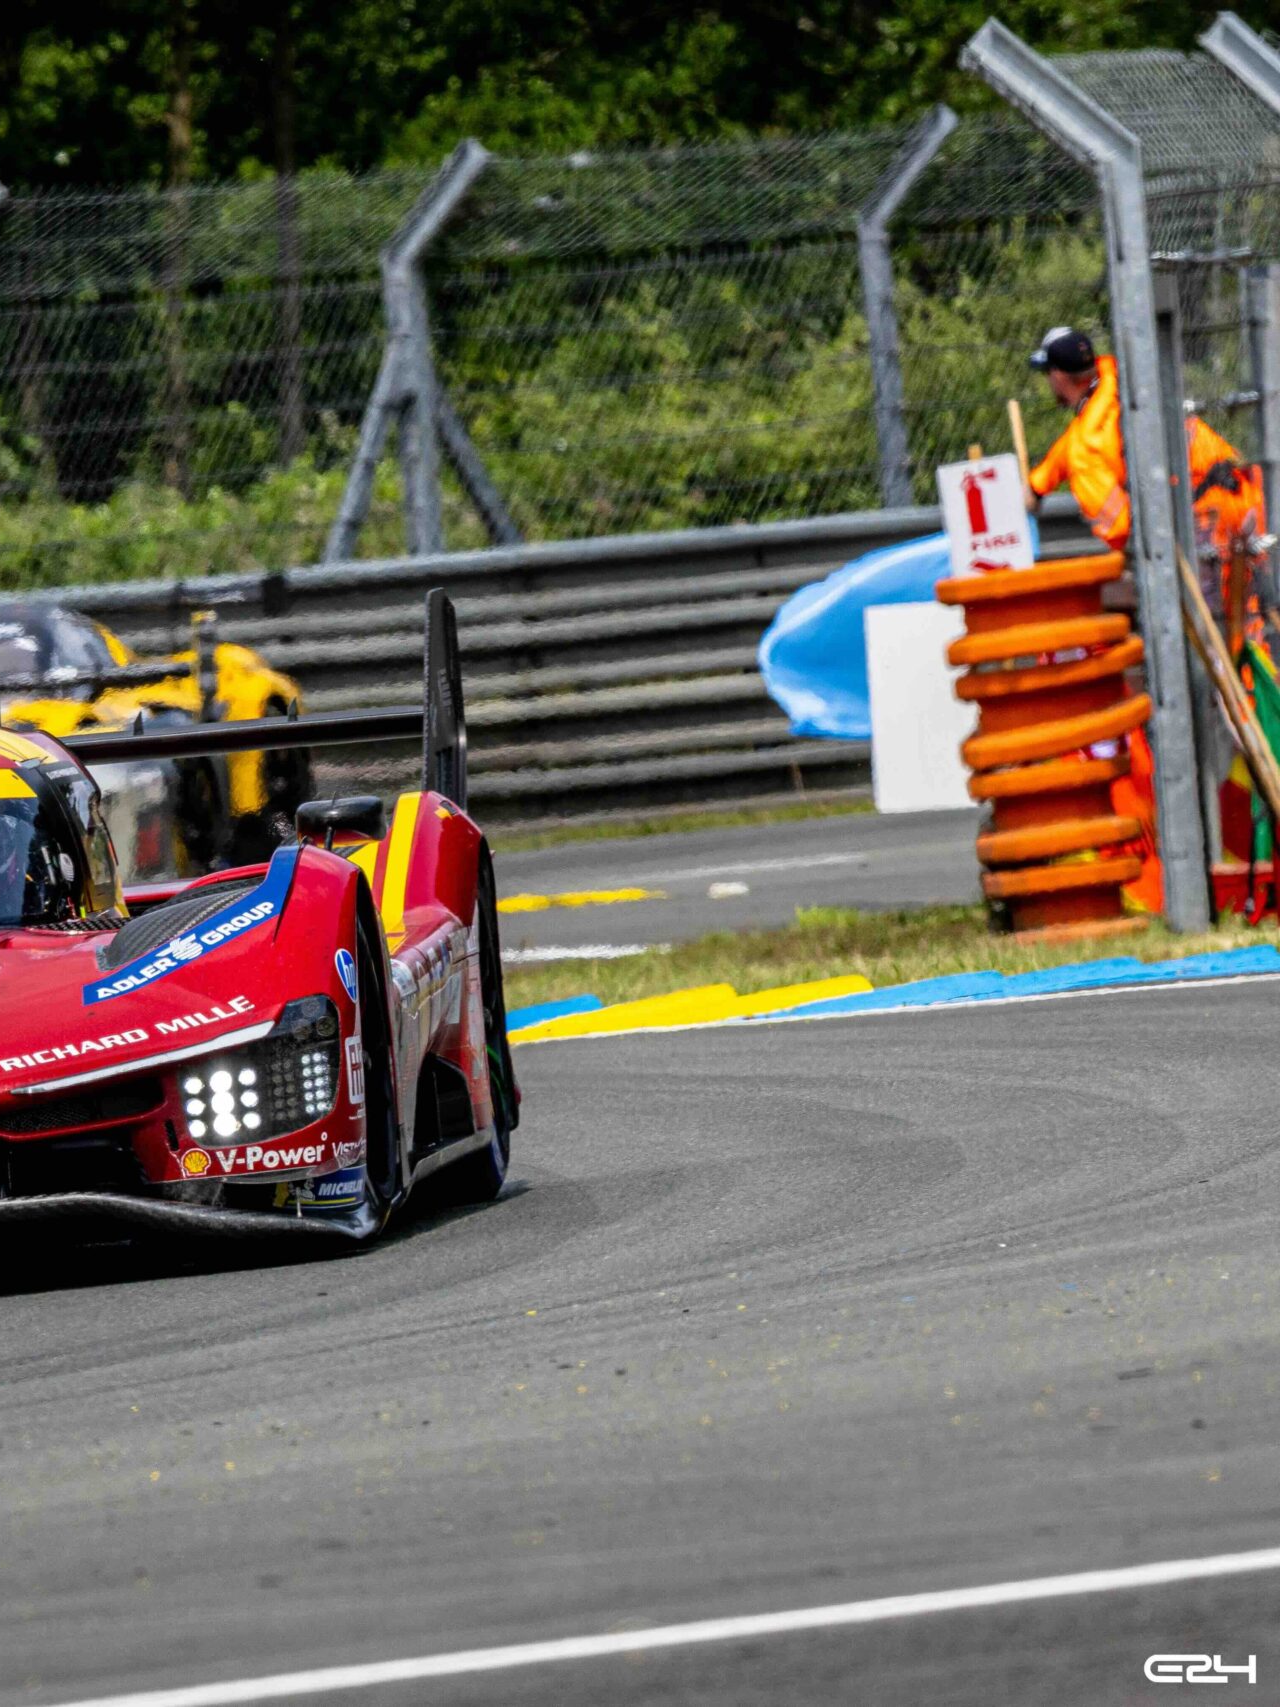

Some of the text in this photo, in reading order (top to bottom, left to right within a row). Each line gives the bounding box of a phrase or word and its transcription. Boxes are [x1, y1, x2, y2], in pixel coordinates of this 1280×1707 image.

[971, 531, 1019, 551] FIRE
[96, 901, 274, 999] ADLER GROUP
[154, 995, 255, 1035] MILLE
[216, 1144, 325, 1173] V-Power
